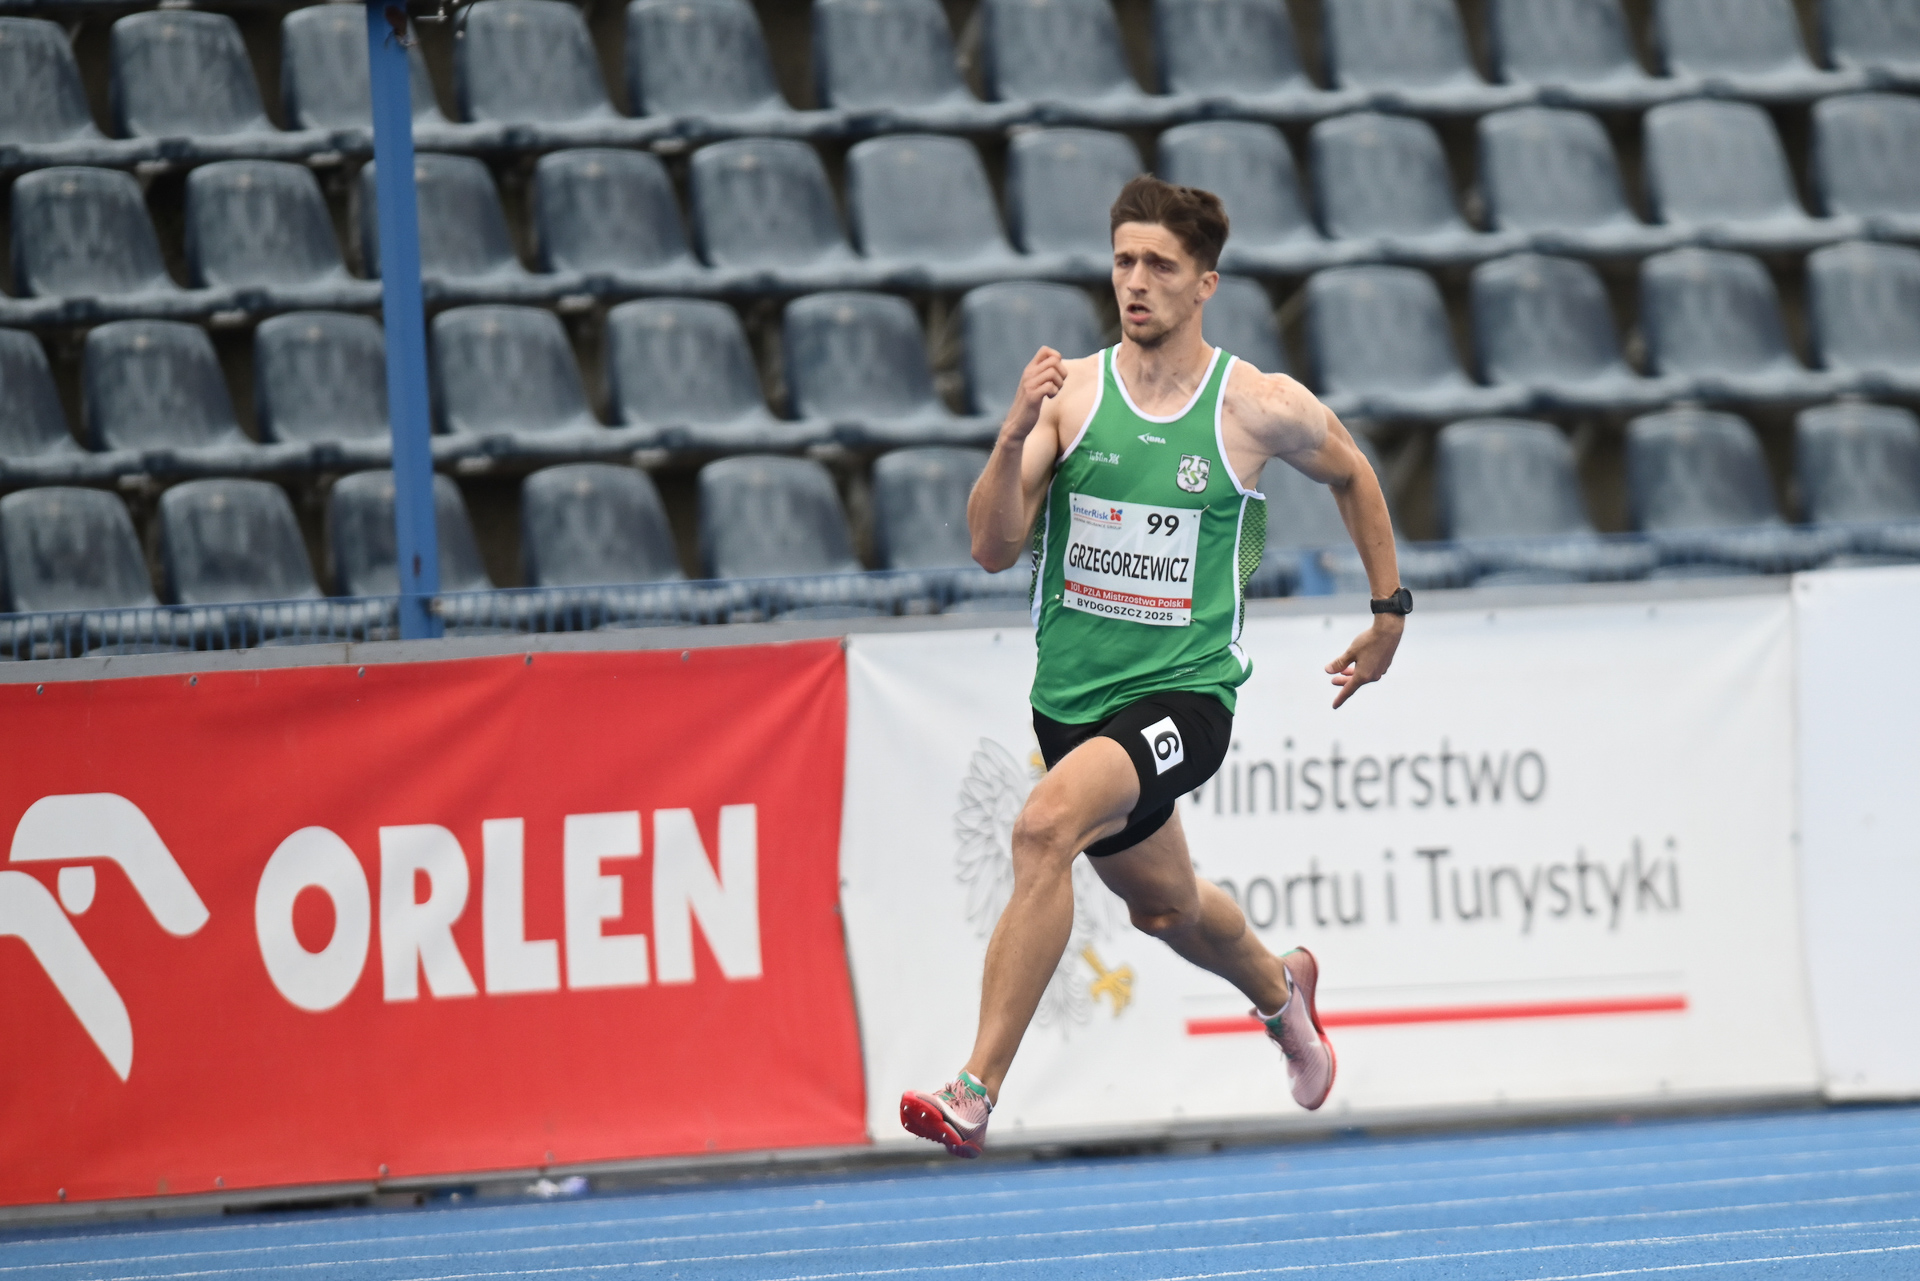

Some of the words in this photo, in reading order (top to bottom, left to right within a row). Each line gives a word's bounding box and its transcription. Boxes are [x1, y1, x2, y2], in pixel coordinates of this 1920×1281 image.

[1073, 504, 1108, 520] InterRisk
[1147, 513, 1180, 537] 99
[1069, 542, 1190, 583] GRZEGORZEWICZ
[1070, 582, 1082, 593] 101.
[1083, 586, 1101, 597] PZLA
[1102, 591, 1156, 607] Mistrzostwa
[1157, 599, 1185, 608] Polski
[1077, 597, 1142, 618] BYDGOSZCZ
[1144, 611, 1173, 621] 2025
[1194, 858, 1366, 929] ortu
[1383, 848, 1398, 923] i
[1416, 836, 1683, 936] Turystyki
[255, 803, 762, 1012] ORLEN
